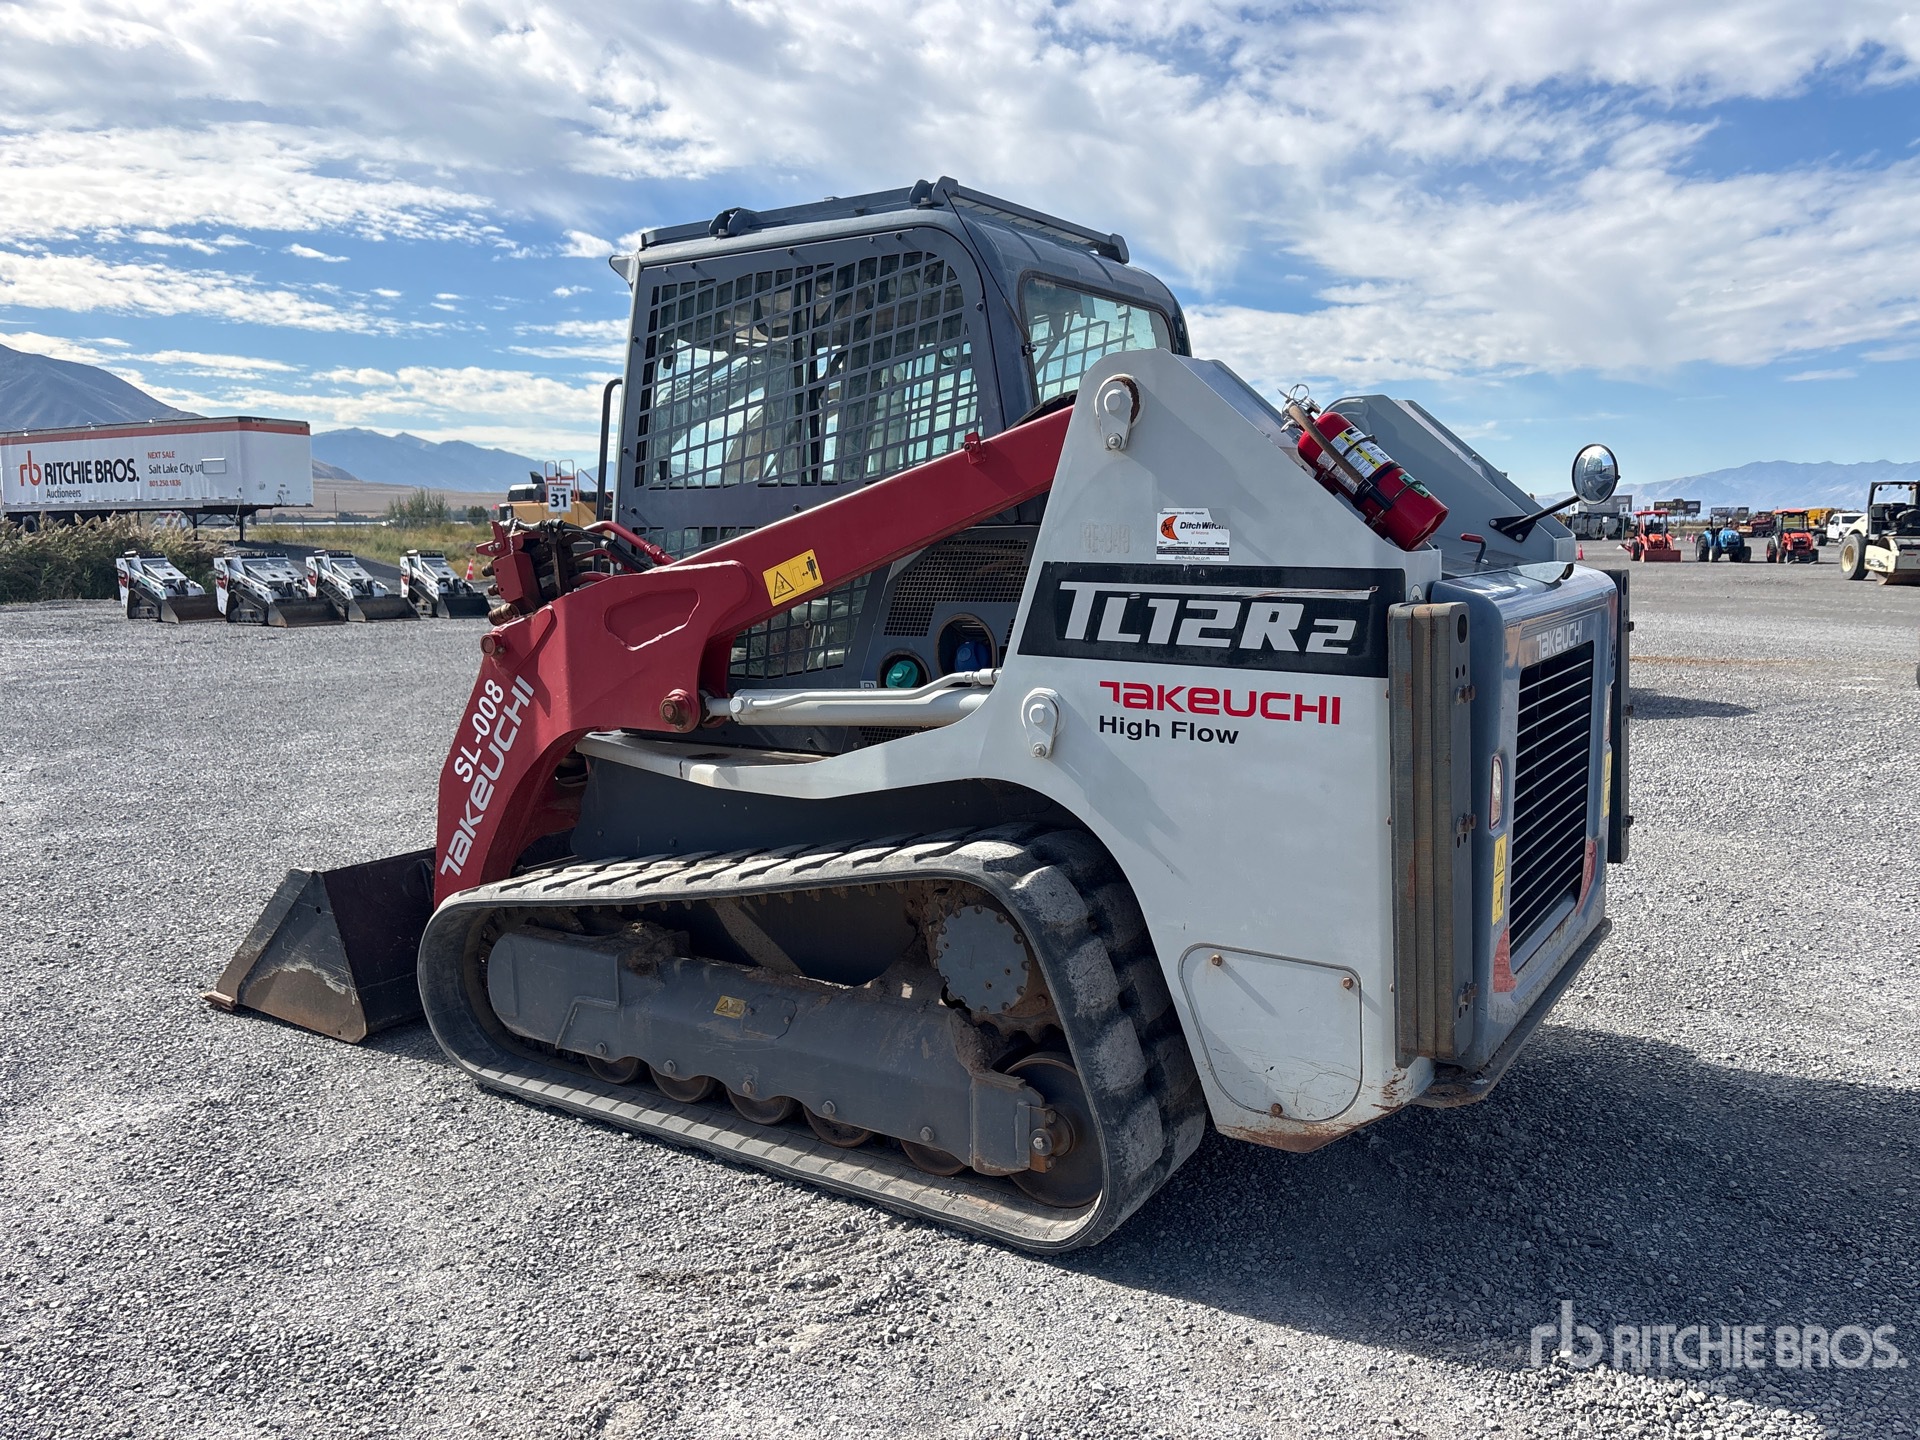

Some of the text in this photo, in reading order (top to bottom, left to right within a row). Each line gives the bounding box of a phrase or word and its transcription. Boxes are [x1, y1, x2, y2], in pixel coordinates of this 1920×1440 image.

[147, 451, 161, 459] NEXT
[148, 464, 162, 474] Salt
[163, 463, 178, 474] Lake
[180, 463, 194, 475] City,
[44, 461, 93, 485] RITCHIE
[95, 458, 140, 483] BROS.
[46, 489, 82, 498] Auctioneers
[550, 493, 567, 507] 31
[1180, 521, 1201, 529] Ditch
[1059, 580, 1379, 655] TL12R2
[1536, 620, 1583, 660] TAKEUCHI
[1100, 681, 1341, 725] TAKEUCHI
[454, 678, 504, 783] SL-008
[1099, 715, 1239, 744] High Flow
[440, 675, 535, 876] TAKEUCHI
